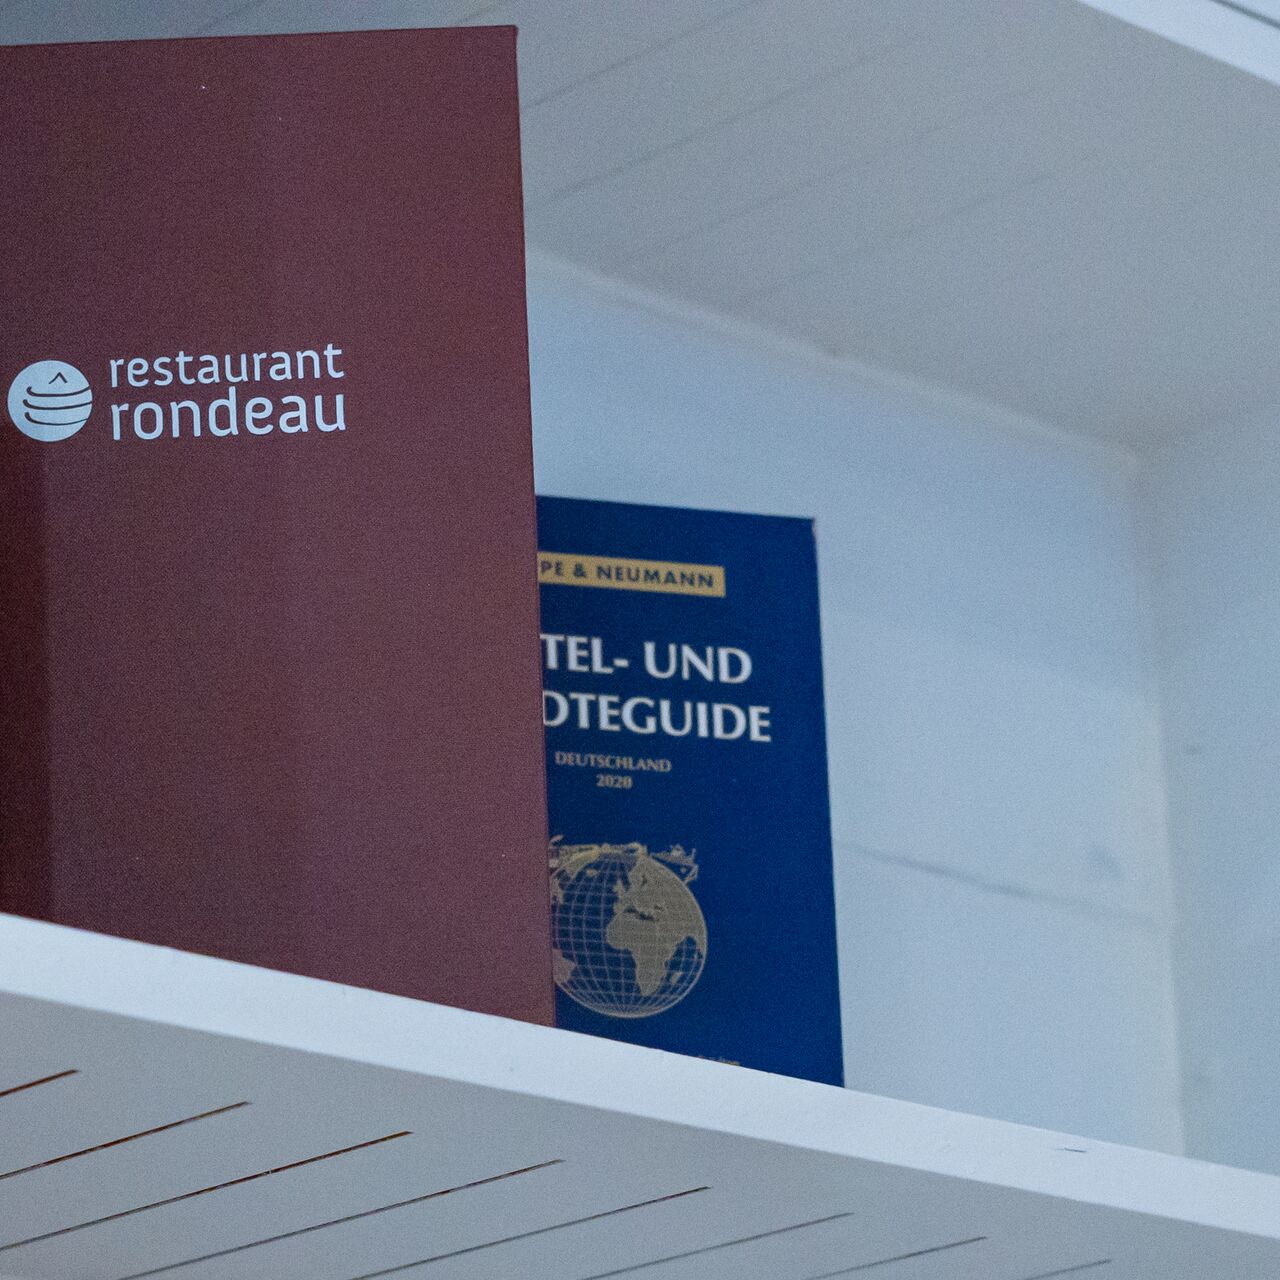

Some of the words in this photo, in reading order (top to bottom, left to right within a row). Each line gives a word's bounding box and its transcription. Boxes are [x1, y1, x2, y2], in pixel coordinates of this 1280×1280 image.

[110, 343, 345, 388] restaurant
[110, 386, 346, 441] rondeau
[573, 562, 586, 578] &
[596, 565, 713, 588] NEUMANN
[644, 641, 753, 684] UND
[555, 750, 672, 773] DEUTSCHLAND
